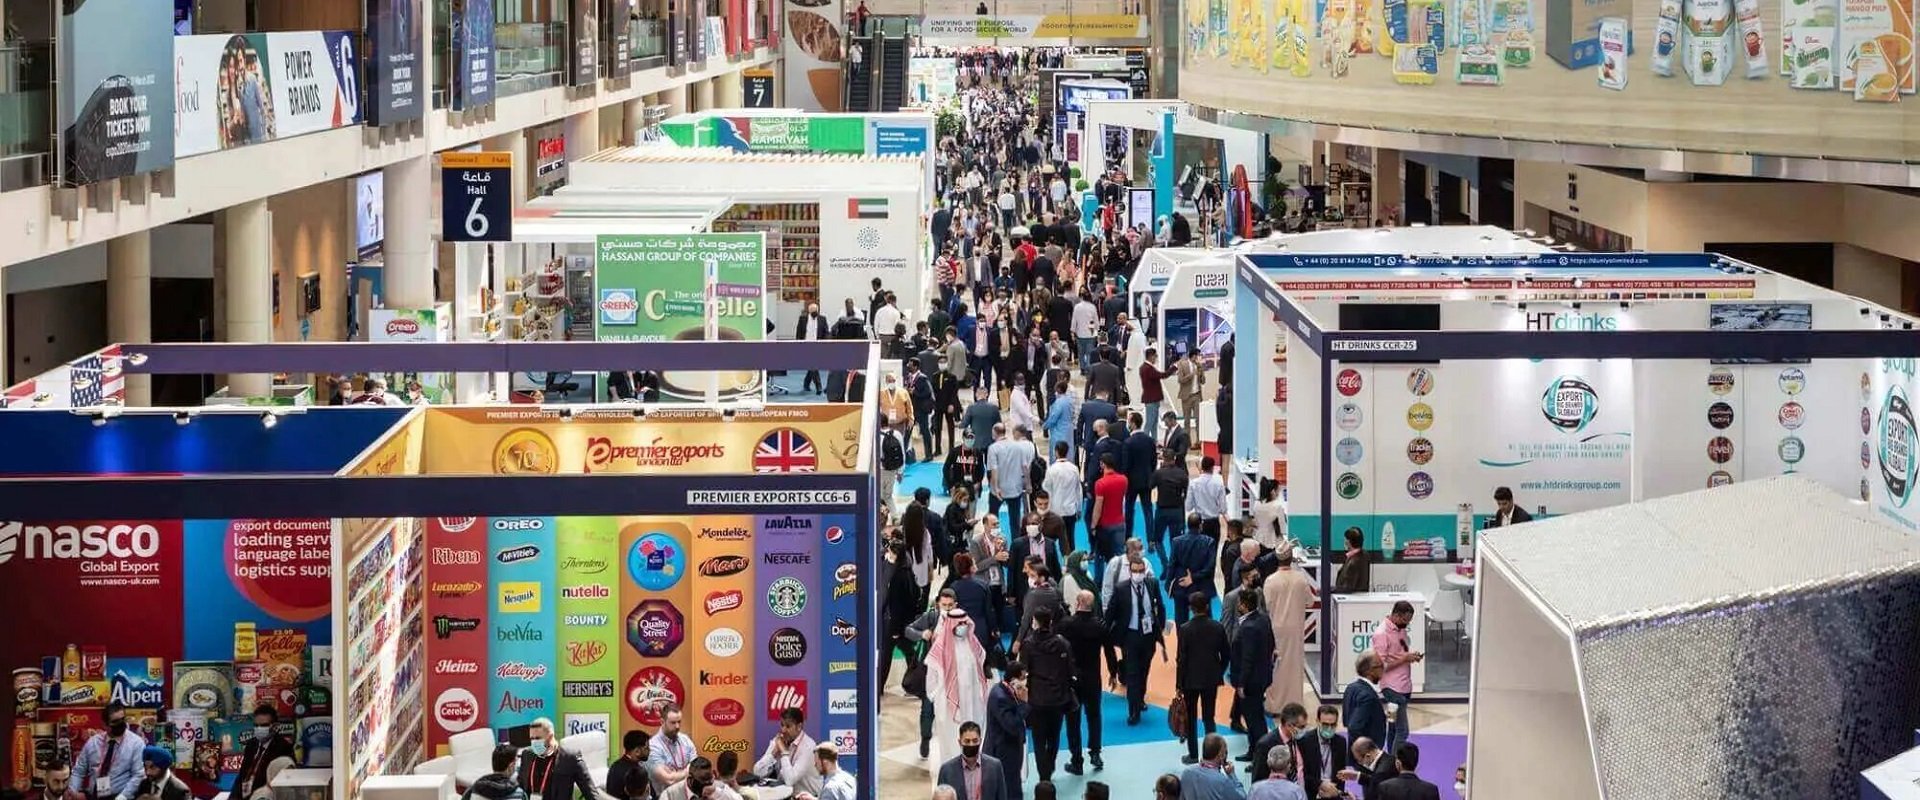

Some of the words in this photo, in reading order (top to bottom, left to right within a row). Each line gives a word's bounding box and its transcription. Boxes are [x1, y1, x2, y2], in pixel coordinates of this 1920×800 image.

[283, 51, 314, 80] POWER
[341, 35, 358, 118] 6
[288, 84, 321, 116] BRANDS
[753, 89, 765, 106] 7
[109, 97, 129, 116] BOOK
[129, 95, 147, 113] YOUR
[106, 118, 135, 138] TICKETS
[135, 115, 151, 134] NOW
[462, 171, 491, 182] قاعة
[467, 185, 487, 195] Hall
[465, 197, 489, 238] 6
[601, 252, 645, 262] HASSANI
[647, 252, 681, 262] GROUP
[684, 252, 698, 262] OF
[699, 251, 757, 263] COMPANIES
[675, 290, 689, 299] The
[601, 300, 637, 311] GREEN'S
[1526, 312, 1616, 331] HTdrinks
[1333, 340, 1346, 351] HT
[1348, 340, 1381, 351] DRINKS
[1383, 340, 1414, 352] CCR-25
[1557, 391, 1583, 402] EXPORT
[487, 411, 518, 419] PREMIER
[519, 411, 551, 419] EXPORTS
[661, 411, 696, 419] EXPORTER
[751, 411, 787, 419] EUROPEAN
[1888, 418, 1908, 441] EXPORT
[1520, 480, 1621, 491] www.htdrinksgroup.com
[692, 492, 751, 503] PREMIER
[754, 492, 811, 503] EXPORTS
[814, 492, 850, 503] CC6-6
[233, 522, 271, 532] export
[494, 519, 544, 531] OREO
[764, 516, 812, 529] LAVAZZA
[24, 524, 160, 559] nasco
[234, 532, 292, 548] loading
[234, 548, 296, 562] language
[432, 547, 481, 565] Ribena
[80, 561, 118, 573] Global
[120, 561, 159, 575] Export
[234, 563, 296, 579] logistics
[560, 556, 609, 574] Thorntons
[80, 578, 160, 586] www.nasco-uk.com
[431, 582, 474, 593] Lucozade
[504, 590, 535, 605] Nesquik
[561, 584, 610, 599] nutella
[773, 606, 801, 617] COFFEE
[564, 615, 608, 626] BOUNTY
[639, 619, 671, 632] Quality
[497, 621, 543, 641] belVita
[642, 630, 668, 638] Street
[774, 642, 802, 653] Dolce
[774, 650, 803, 660] Gusto
[434, 660, 479, 674] Heinz
[497, 662, 547, 681] Kellogg's
[110, 681, 162, 707] Alpen
[564, 682, 613, 697] HERSHEY'S
[496, 690, 545, 714] Alpen
[771, 685, 805, 710] illy
[441, 706, 472, 717] Cerelac
[710, 713, 737, 721] LINDOR
[567, 719, 607, 737] Ritter
[703, 735, 749, 753] Reese's
